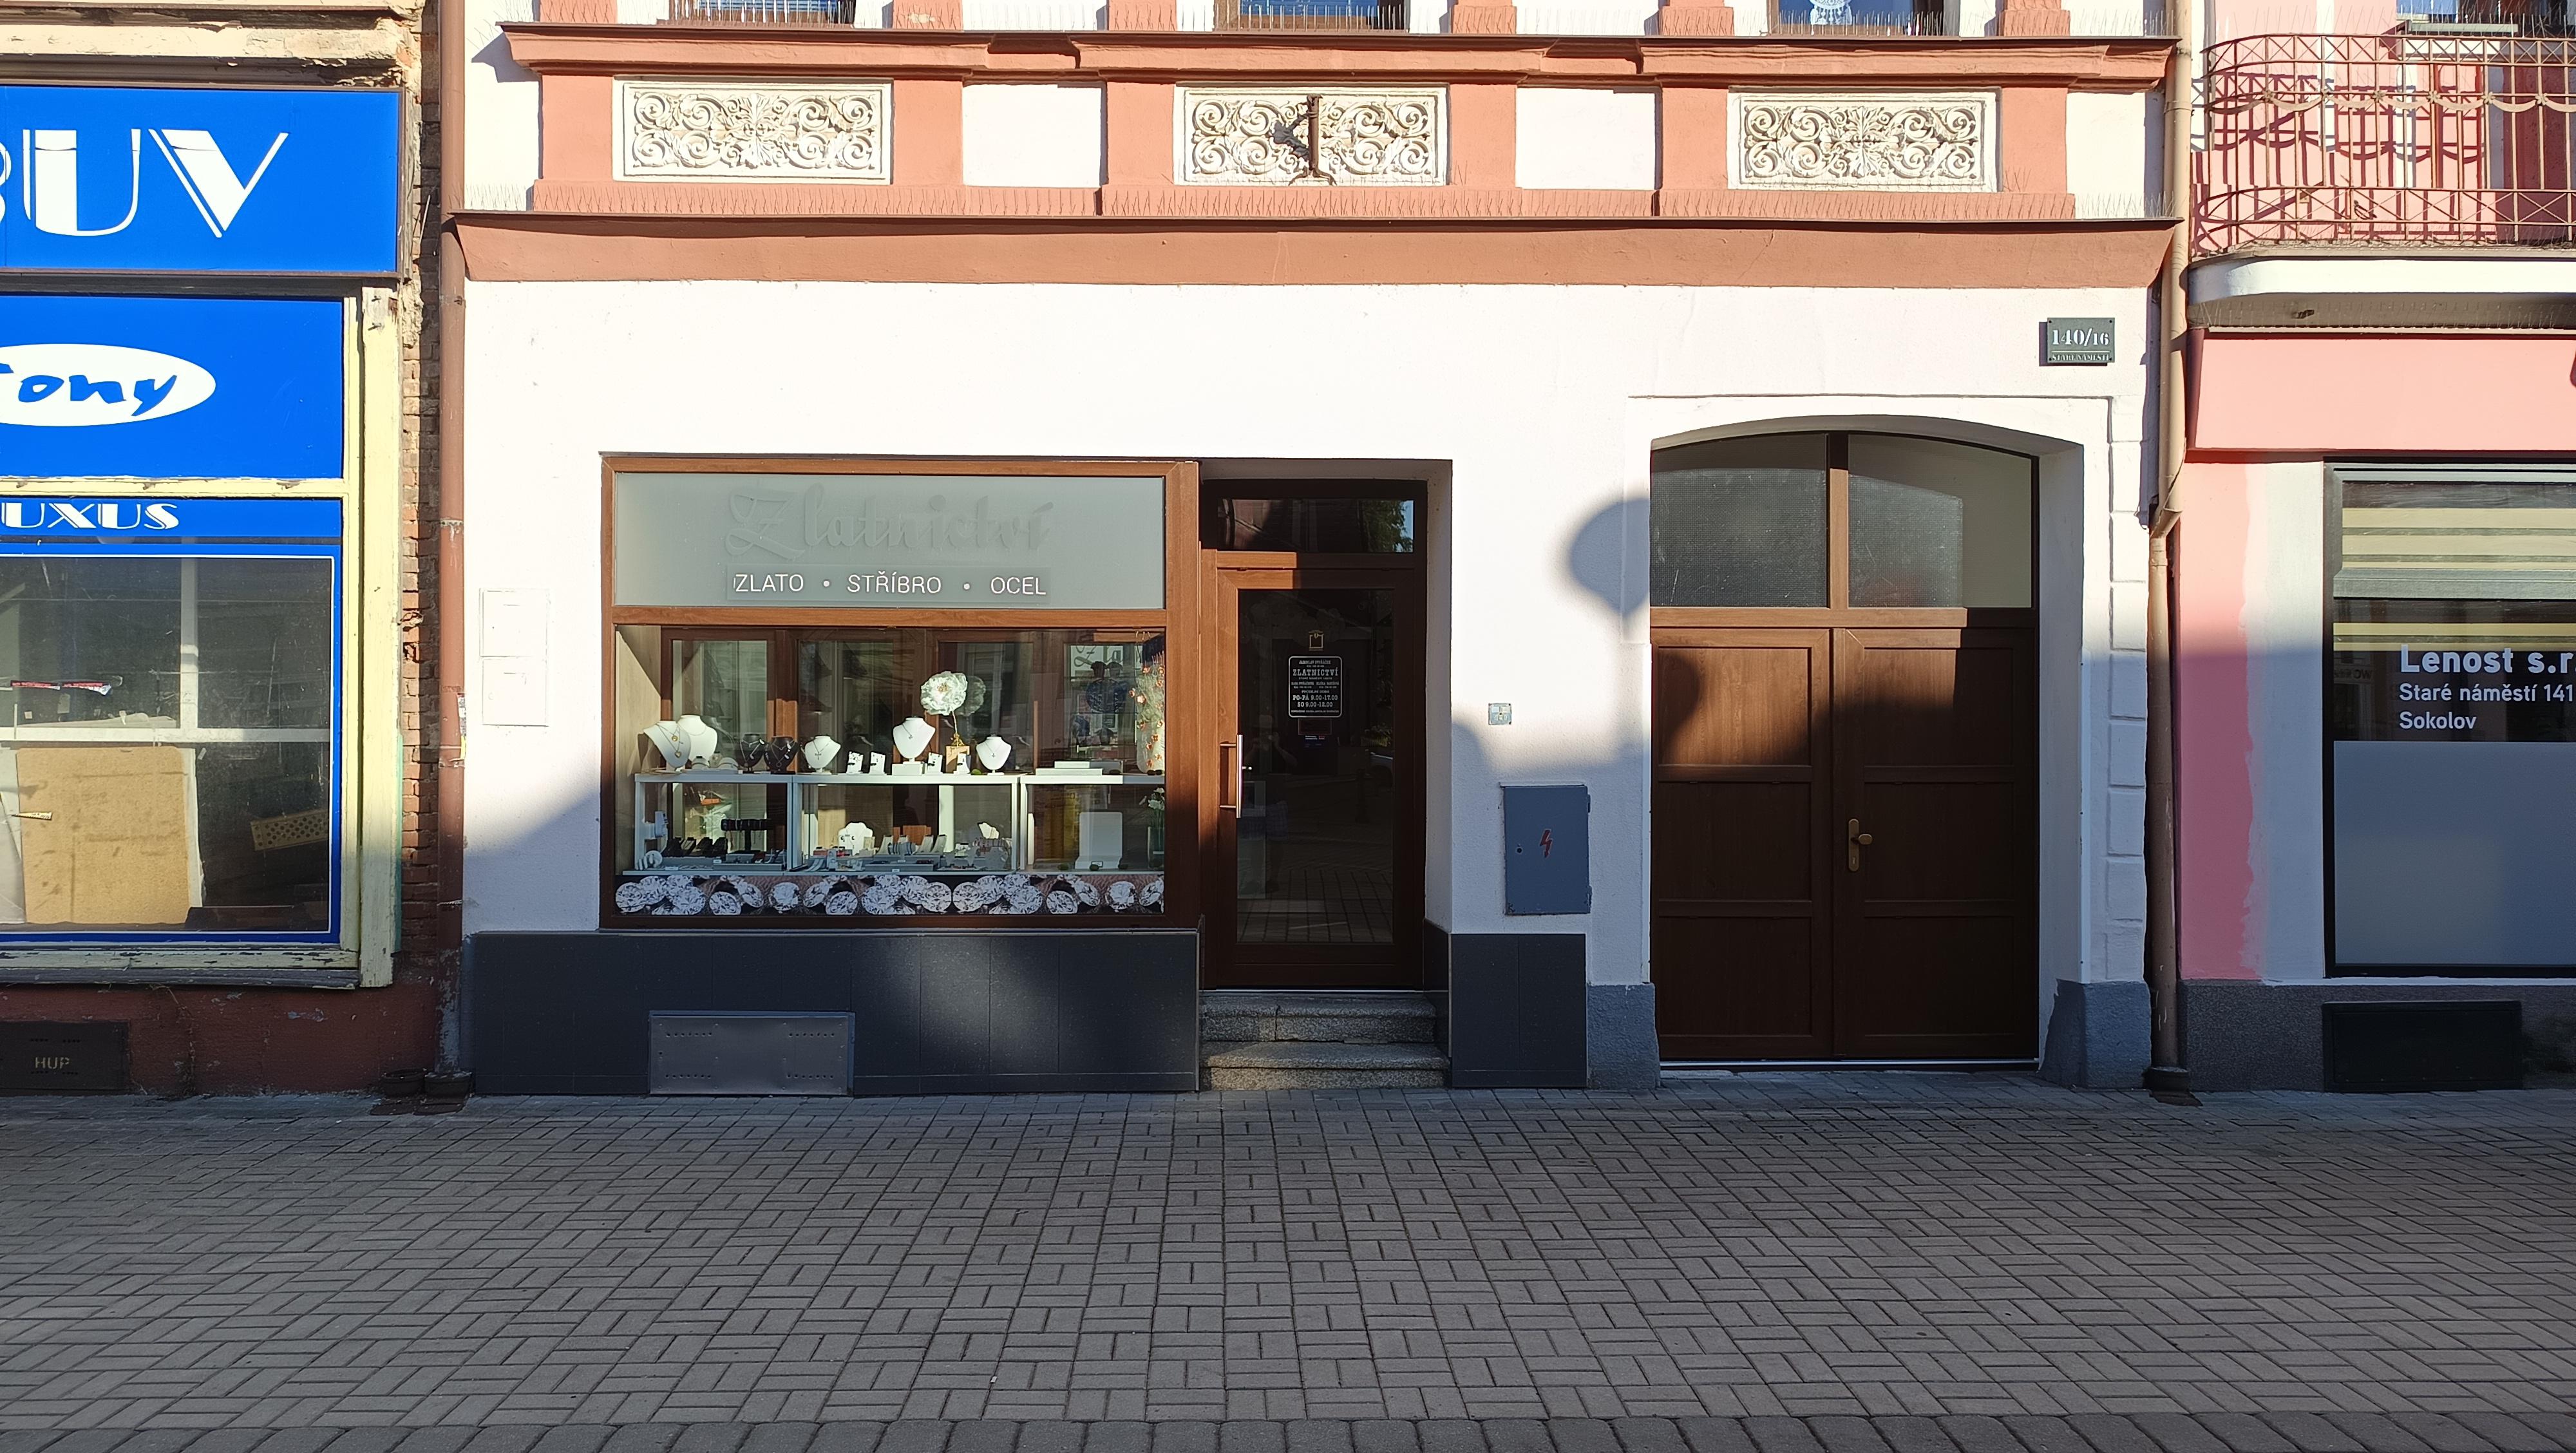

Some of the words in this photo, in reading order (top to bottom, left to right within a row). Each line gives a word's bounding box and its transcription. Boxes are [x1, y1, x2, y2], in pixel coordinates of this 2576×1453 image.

[0, 128, 289, 238] UV
[2052, 328, 2110, 347] 140/16
[0, 363, 178, 417] ony
[735, 574, 804, 593] ZLATO
[846, 570, 942, 594] STŘÍBRO
[990, 576, 1046, 595] OCEL
[2401, 644, 2514, 673] Lenost
[2527, 652, 2576, 674] s.r
[1293, 667, 1338, 676] ZLATNICTVÍ
[2399, 683, 2452, 701] Staré
[2459, 683, 2537, 702] náměstí
[2544, 684, 2573, 702] 141
[2400, 711, 2477, 729] Sokolov
[34, 1056, 70, 1070] HUP
